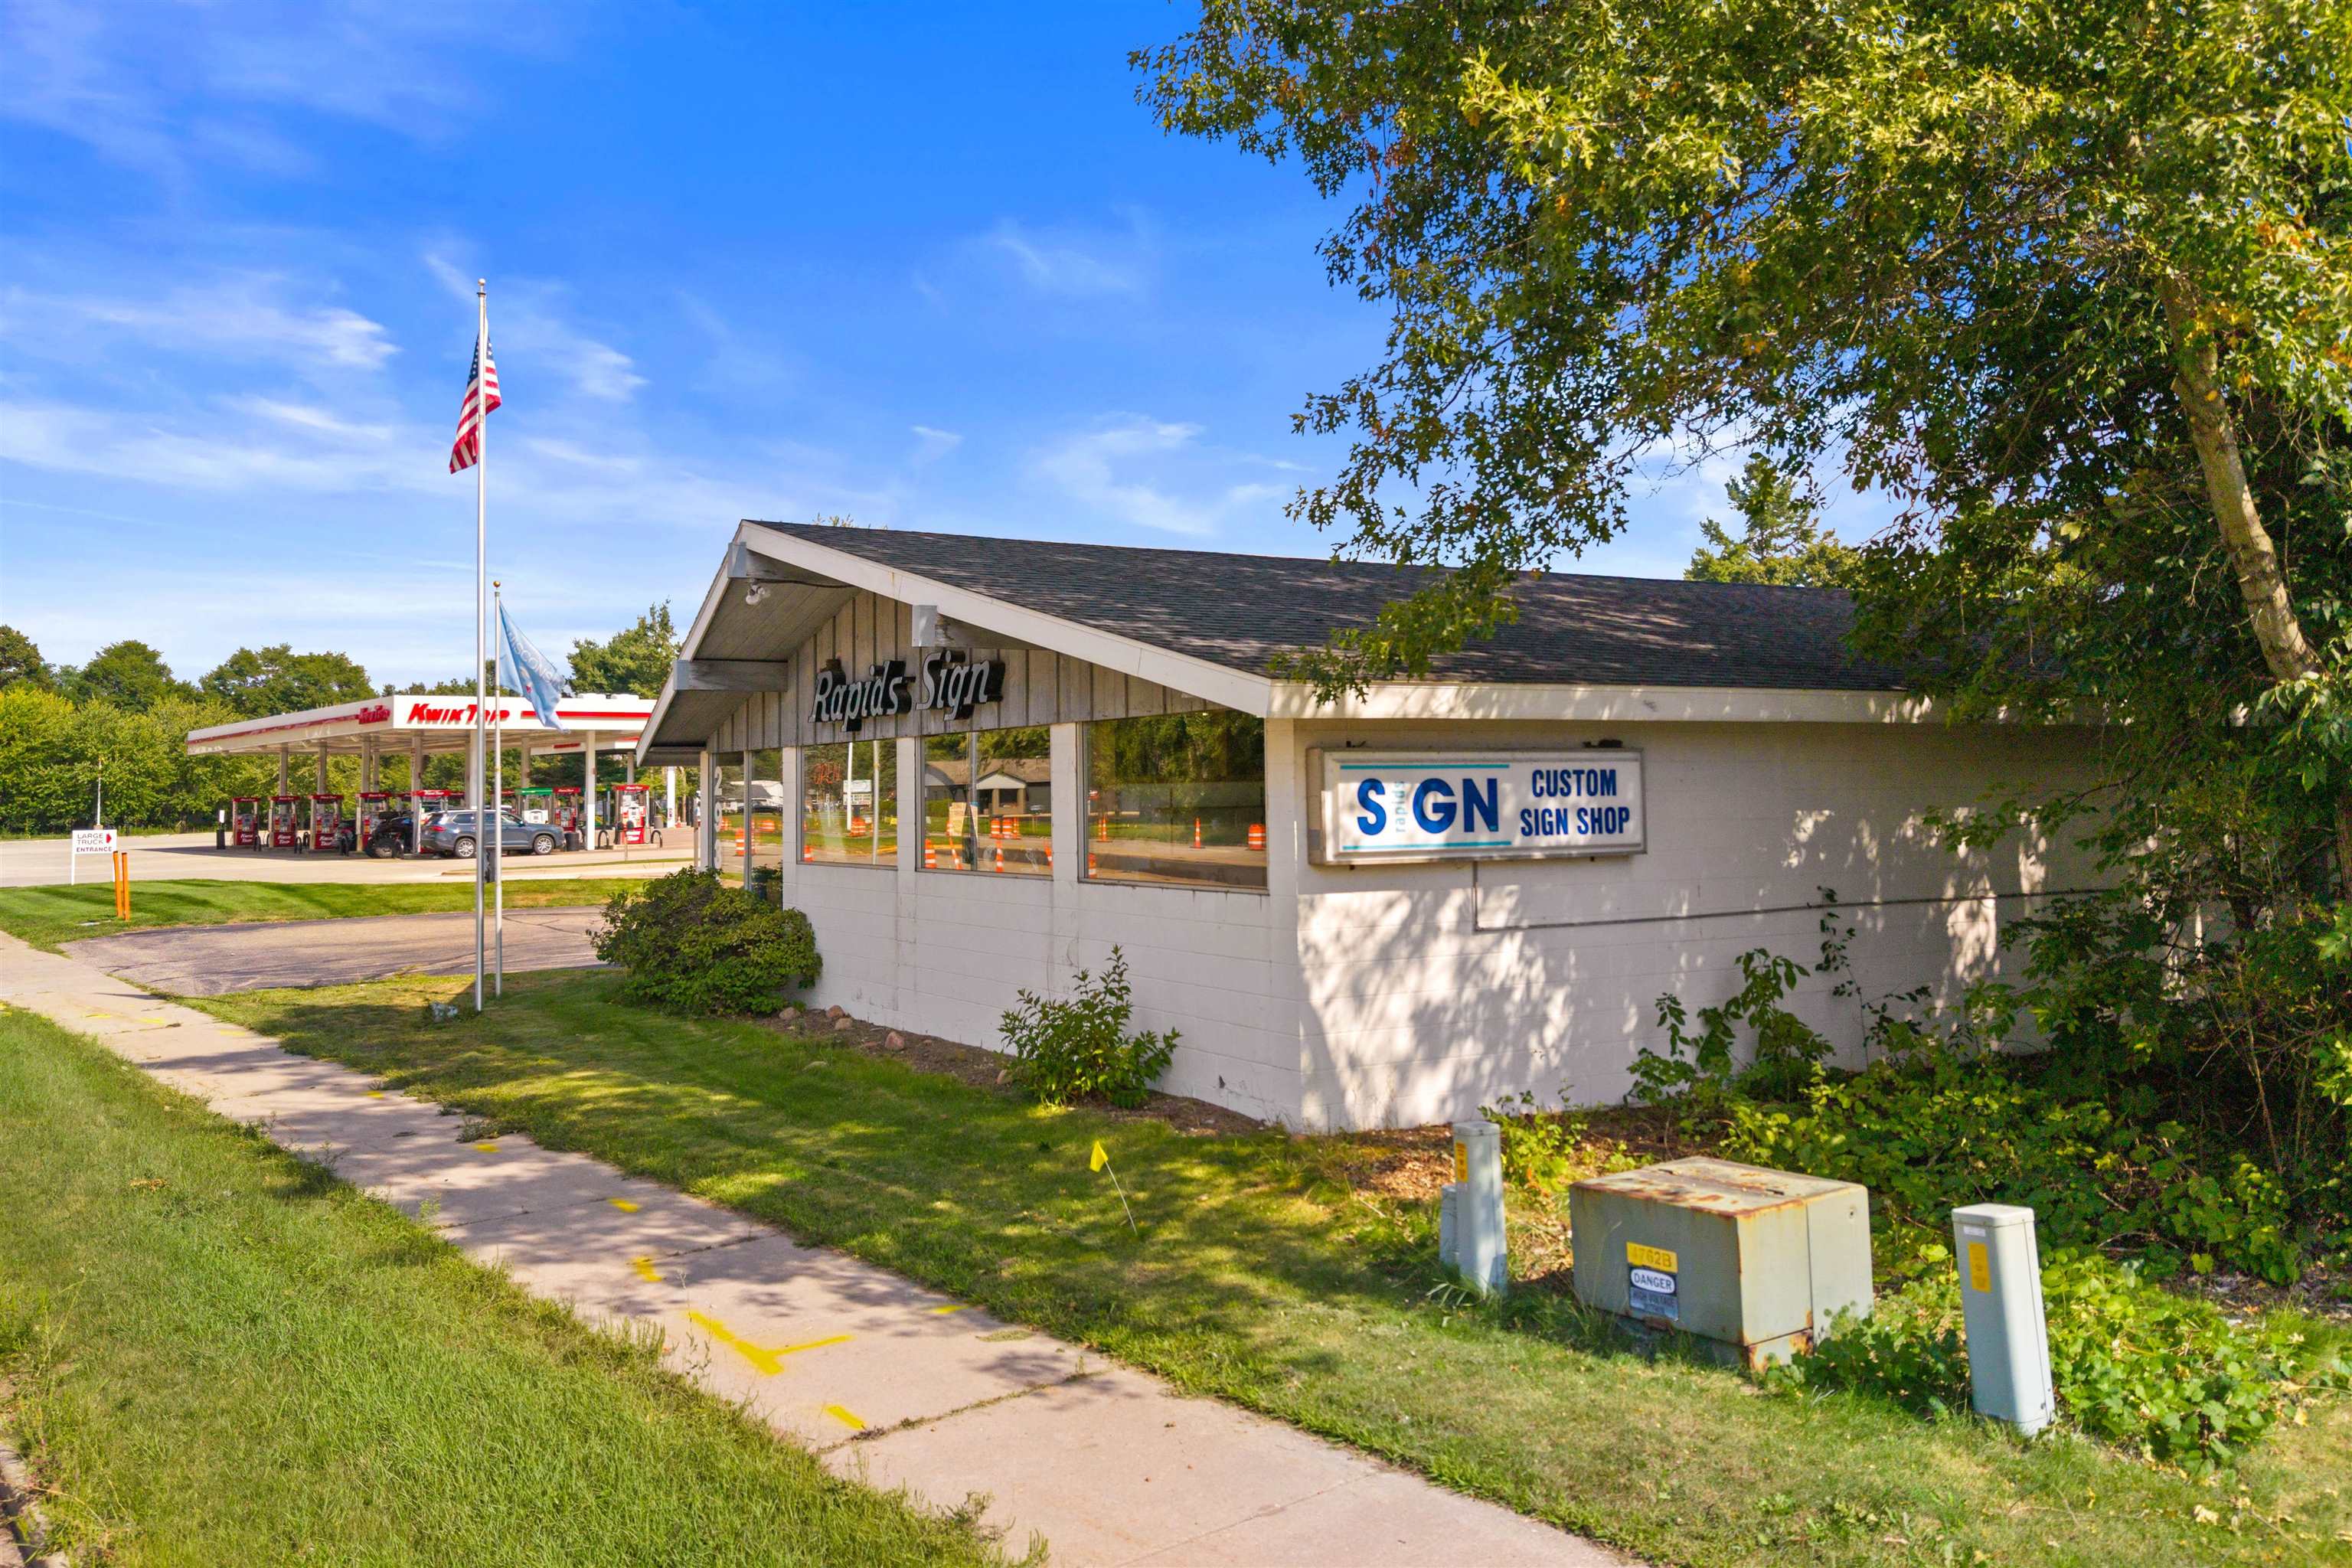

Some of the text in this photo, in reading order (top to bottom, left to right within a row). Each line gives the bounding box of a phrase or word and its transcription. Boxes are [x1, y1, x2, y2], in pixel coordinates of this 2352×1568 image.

[808, 650, 991, 733] Rapids Sign
[1532, 769, 1617, 798] CUSTOM
[1393, 780, 1408, 833] rapids
[1520, 807, 1630, 837] SIGN SHOP
[1634, 1272, 1673, 1291] DANGER
